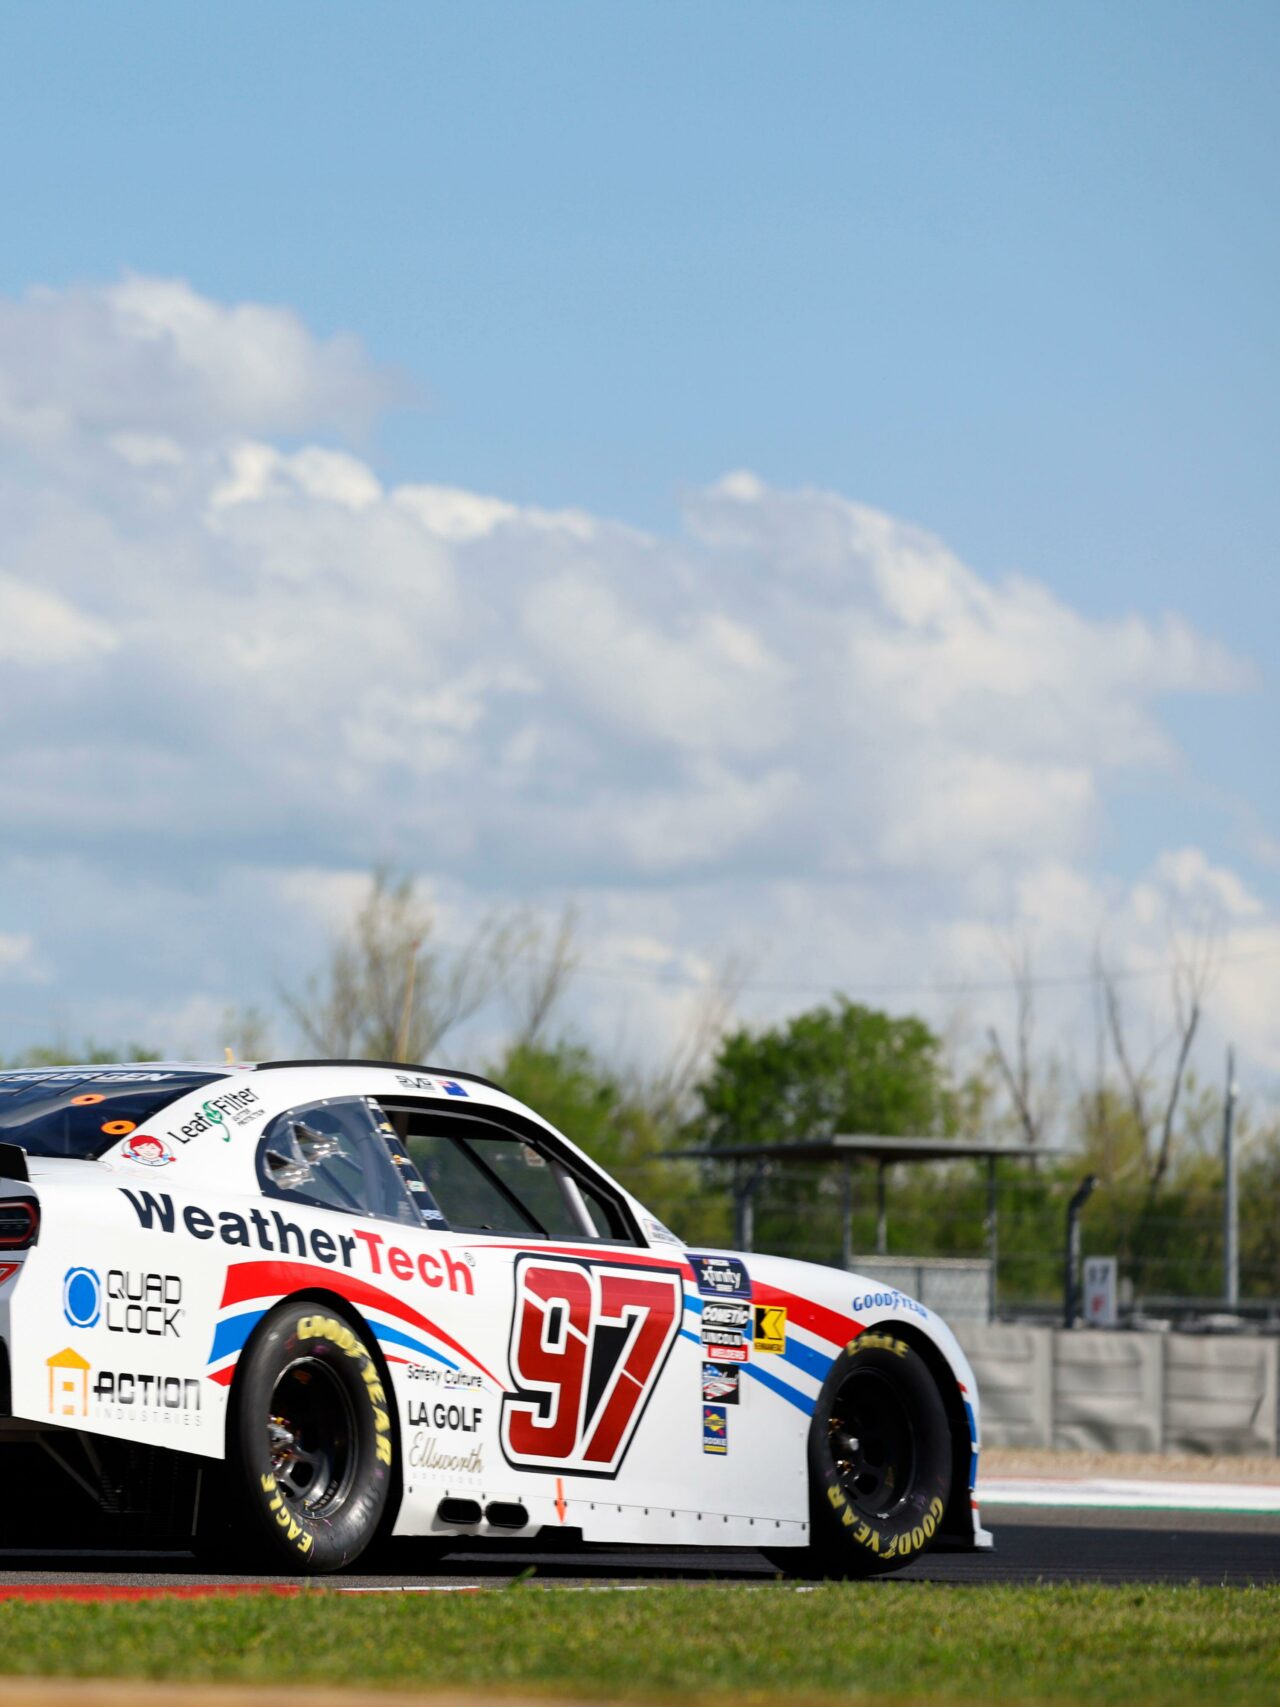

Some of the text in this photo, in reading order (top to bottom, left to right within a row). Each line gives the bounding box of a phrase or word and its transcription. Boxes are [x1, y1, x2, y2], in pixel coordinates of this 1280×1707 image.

[107, 1270, 182, 1304] QUAD
[700, 1265, 742, 1289] xfinity
[106, 1302, 181, 1338] LOCK
[701, 1307, 749, 1324] COMETIC
[852, 1291, 928, 1319] GOODYEAR
[702, 1329, 742, 1346] LINCOLN
[499, 1252, 684, 1480] 97
[93, 1371, 201, 1411] ACTION
[408, 1400, 483, 1432] LA GOLF
[408, 1431, 484, 1474] Ellsworth
[261, 1472, 313, 1553] EAGLE
[826, 1484, 944, 1559] GOODYEAR
